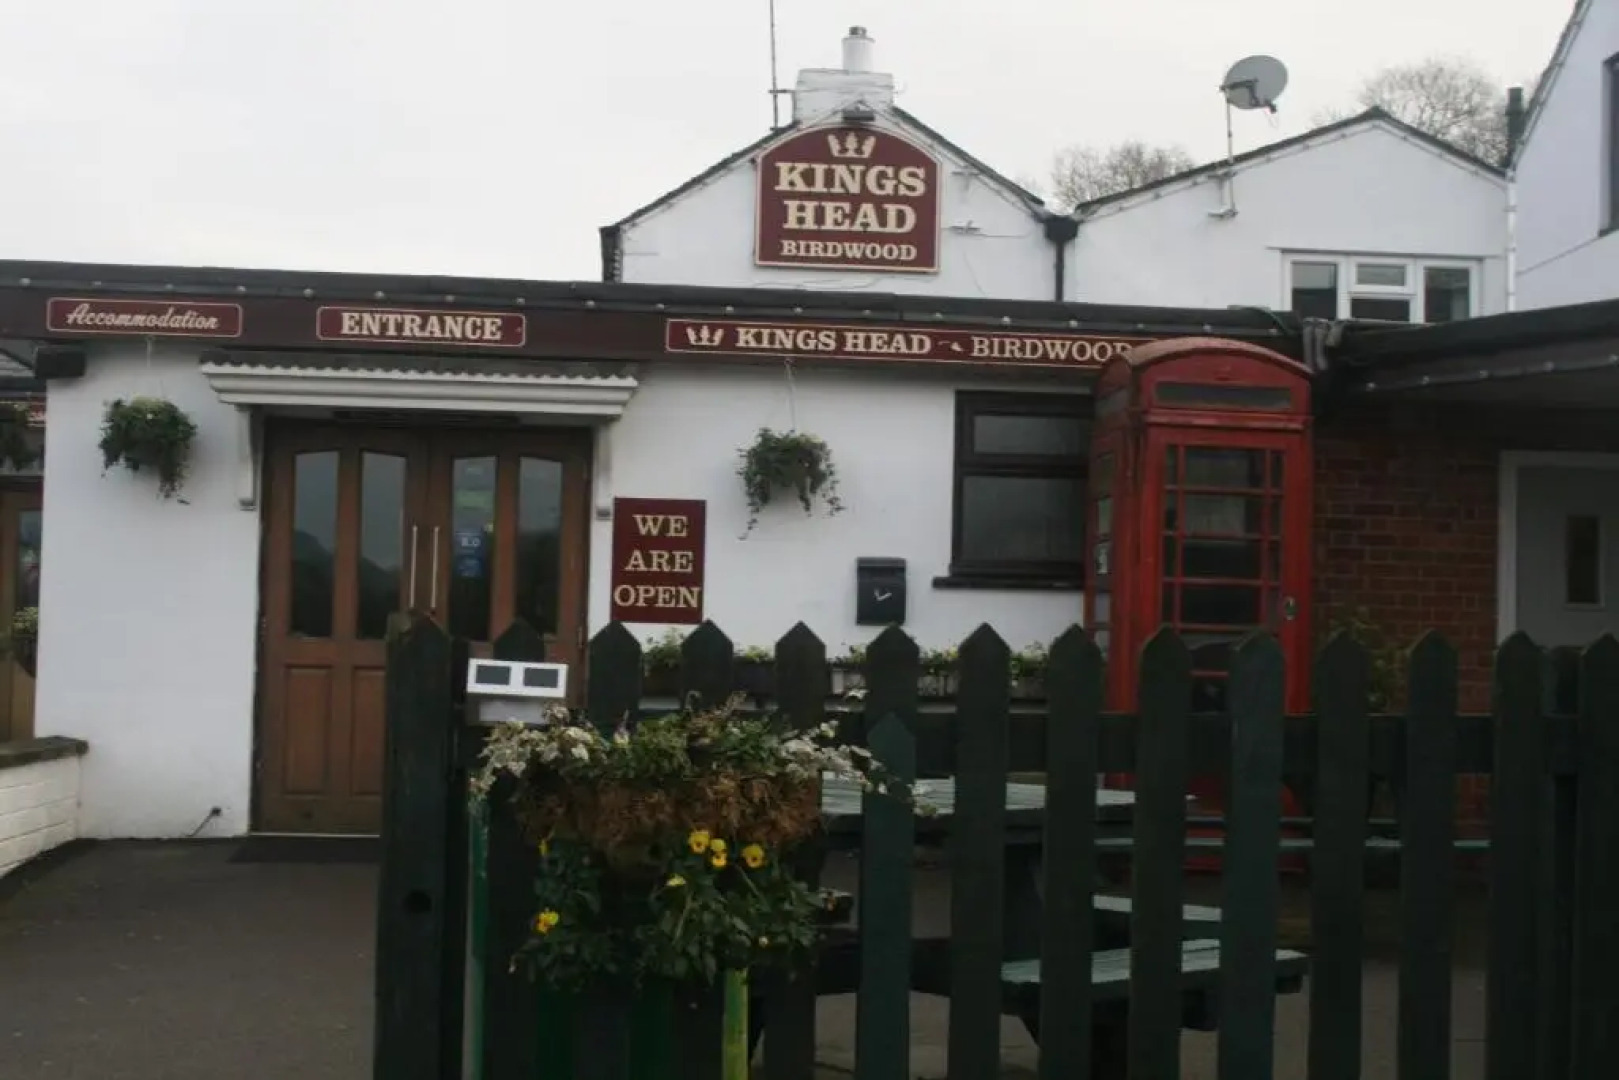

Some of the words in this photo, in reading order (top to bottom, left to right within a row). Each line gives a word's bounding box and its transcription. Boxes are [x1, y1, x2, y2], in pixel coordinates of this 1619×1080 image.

[775, 162, 926, 197] KINGS
[782, 200, 917, 234] HEAD
[780, 239, 918, 261] BIRDWOOD
[66, 303, 220, 330] Accommodation
[340, 312, 502, 340] ENTRANCE
[735, 327, 836, 351] KINGS
[843, 331, 932, 355] HEAD
[632, 514, 689, 537] WE
[624, 550, 694, 573] ARE
[613, 584, 702, 608] OPEN
